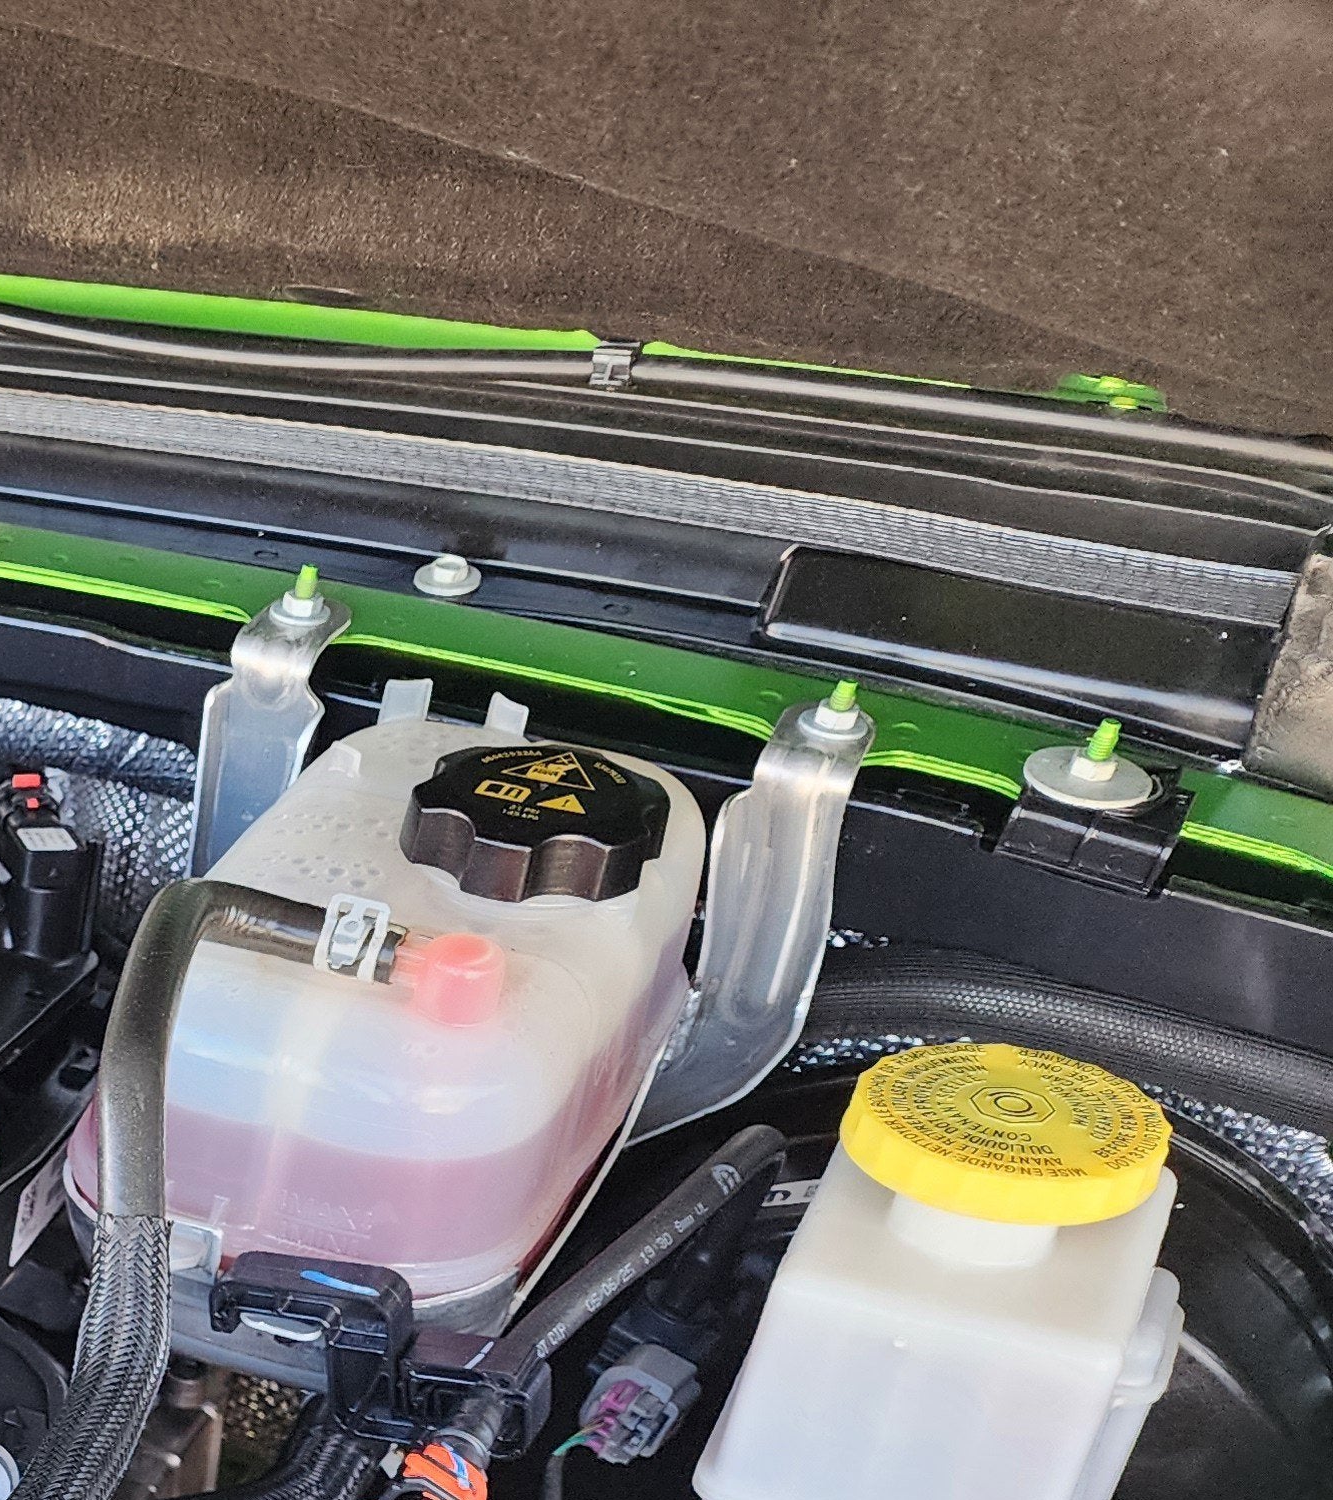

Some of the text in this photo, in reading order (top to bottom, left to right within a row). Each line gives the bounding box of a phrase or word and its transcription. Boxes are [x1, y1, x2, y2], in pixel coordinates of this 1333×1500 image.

[1018, 1049, 1105, 1076] CONTAINER
[1018, 1060, 1062, 1072] ONLY
[1066, 1071, 1097, 1086] USE
[1103, 1076, 1148, 1103] SEALED
[1041, 1074, 1113, 1141] CLEAN FILLER CAP
[928, 1116, 958, 1134] DOT
[937, 1101, 1031, 1142] CONTENANT
[885, 1119, 952, 1157] NETTOYER
[959, 1133, 1025, 1153] LIQUIDE
[1093, 1132, 1136, 1158] BEFORE
[956, 1145, 980, 1154] LE
[982, 1149, 1005, 1160] DE
[1031, 1144, 1053, 1154] DU
[1010, 1156, 1063, 1165] AVANT
[1107, 1156, 1137, 1170] DOT
[1020, 1166, 1042, 1176] EN
[1050, 1168, 1088, 1176] MISE
